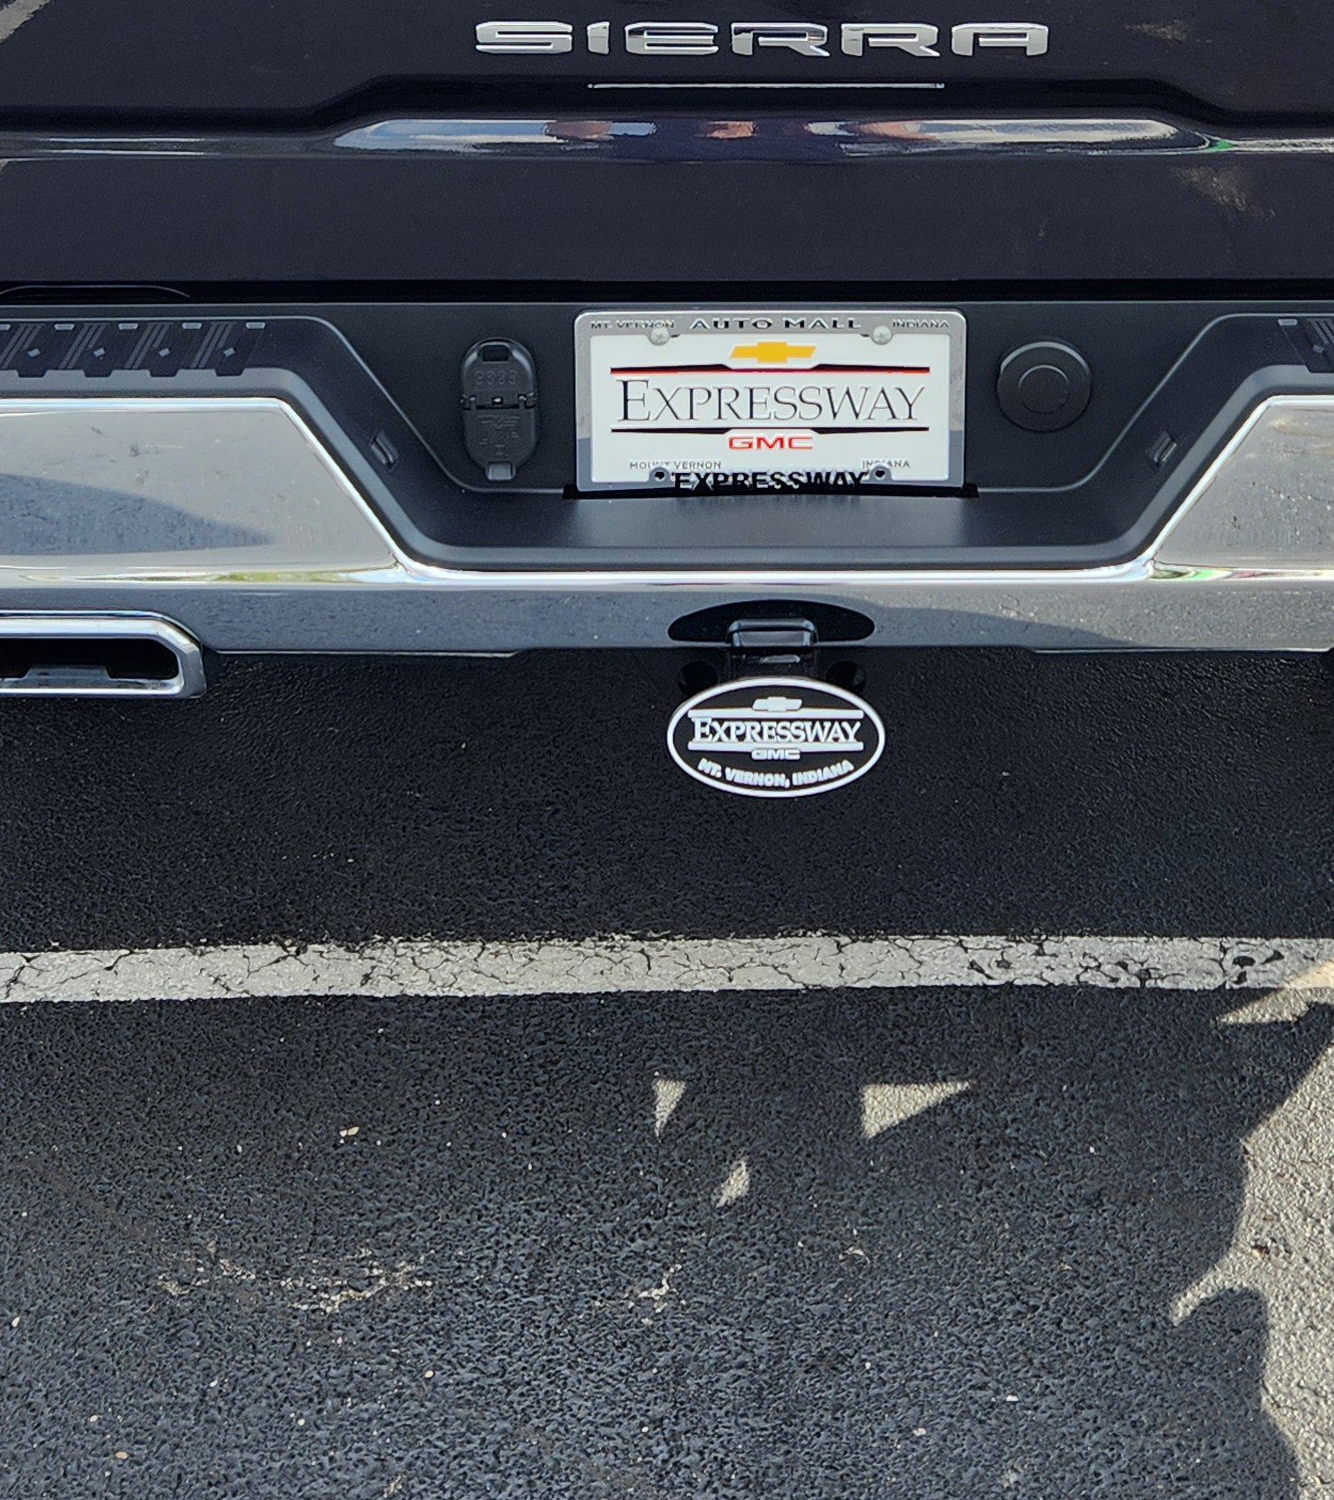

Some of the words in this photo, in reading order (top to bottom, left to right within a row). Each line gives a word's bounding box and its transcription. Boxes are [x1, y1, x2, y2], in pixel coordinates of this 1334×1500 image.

[475, 21, 1050, 57] SIERRA
[690, 317, 773, 329] AUTO
[782, 317, 861, 329] MALL
[891, 318, 950, 329] INDIANA
[616, 379, 925, 421] EXPRESSWAY
[728, 436, 814, 450] GMC
[674, 460, 722, 470] VERNON
[674, 470, 868, 491] EXPRESSWAY
[691, 716, 861, 744] EXPRESSWAY
[751, 748, 801, 760] GMC
[697, 757, 723, 778] MT.
[724, 766, 790, 789] VERNON,
[792, 759, 855, 786] INDIANA
